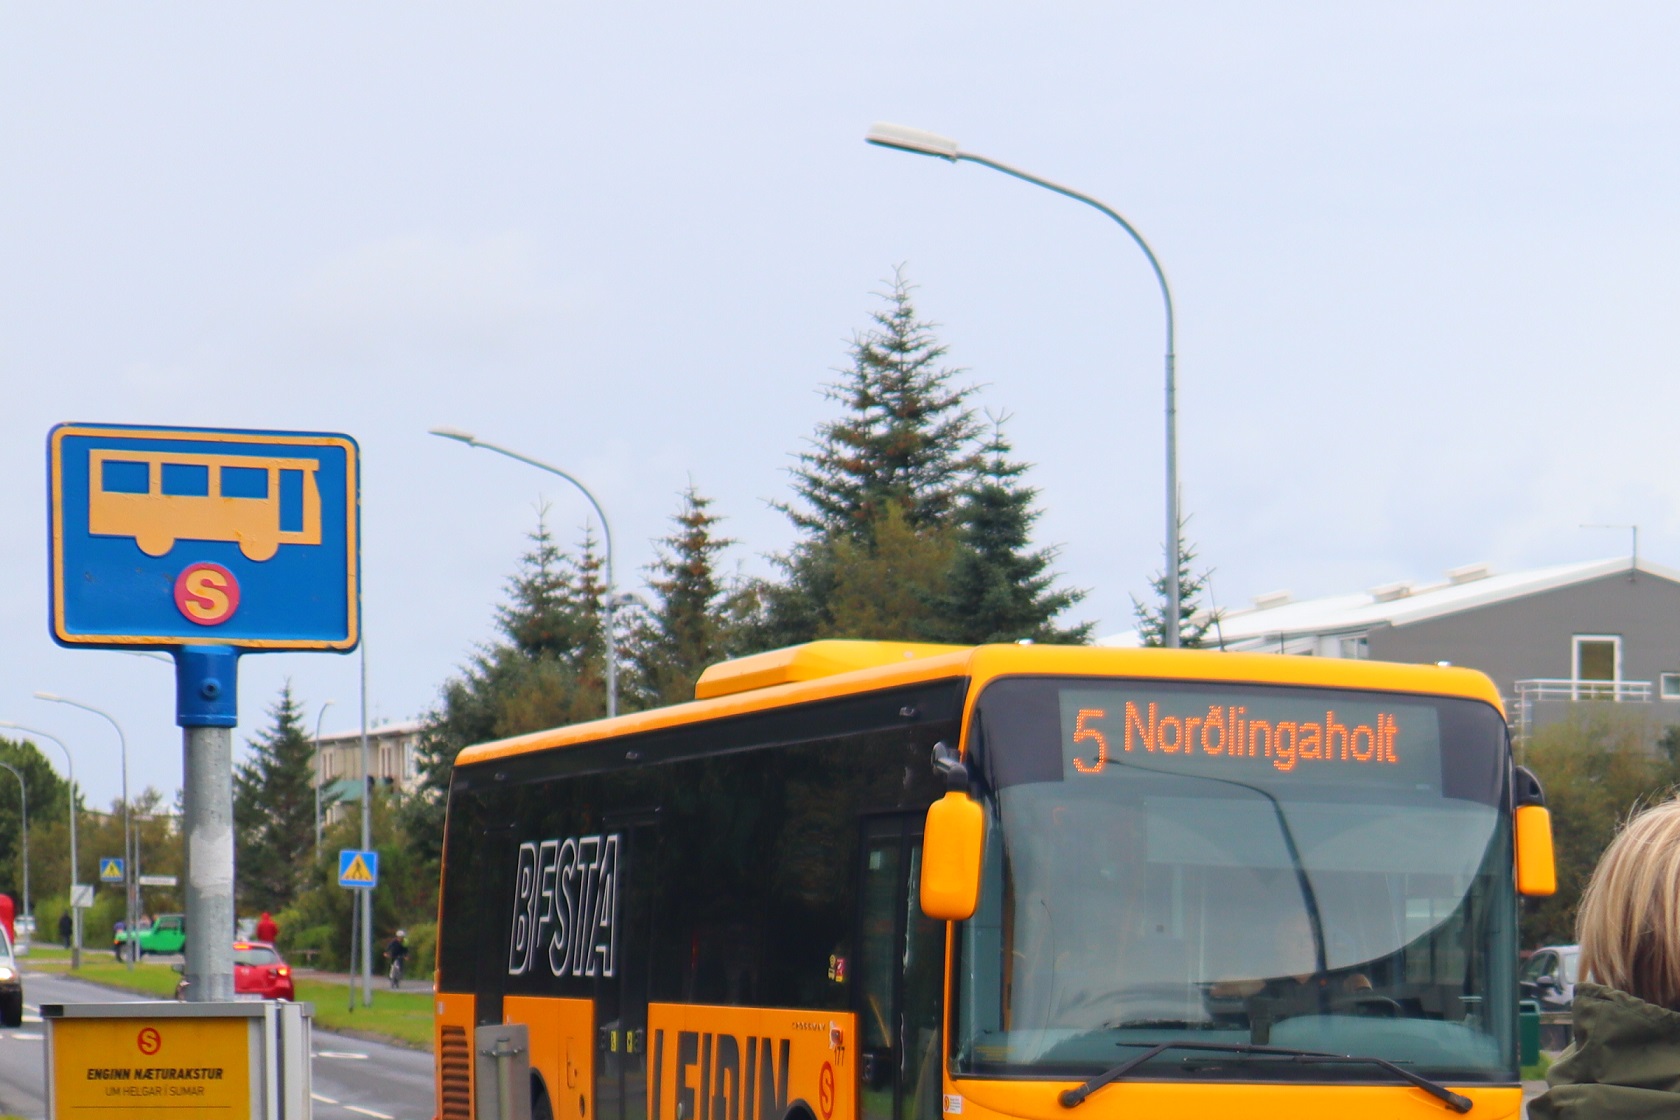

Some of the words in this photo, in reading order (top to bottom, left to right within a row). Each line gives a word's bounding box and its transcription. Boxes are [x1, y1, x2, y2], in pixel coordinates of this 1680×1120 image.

[184, 569, 230, 620] S
[1073, 708, 1106, 773] 5
[834, 1046, 845, 1066] 177
[87, 1068, 130, 1080] ENGINN
[134, 1068, 223, 1080] NÆTURAKSTUR
[105, 1086, 121, 1096] UM
[123, 1085, 162, 1096] HELGAR
[169, 1085, 204, 1096] SUMAR
[820, 1063, 833, 1118] S
